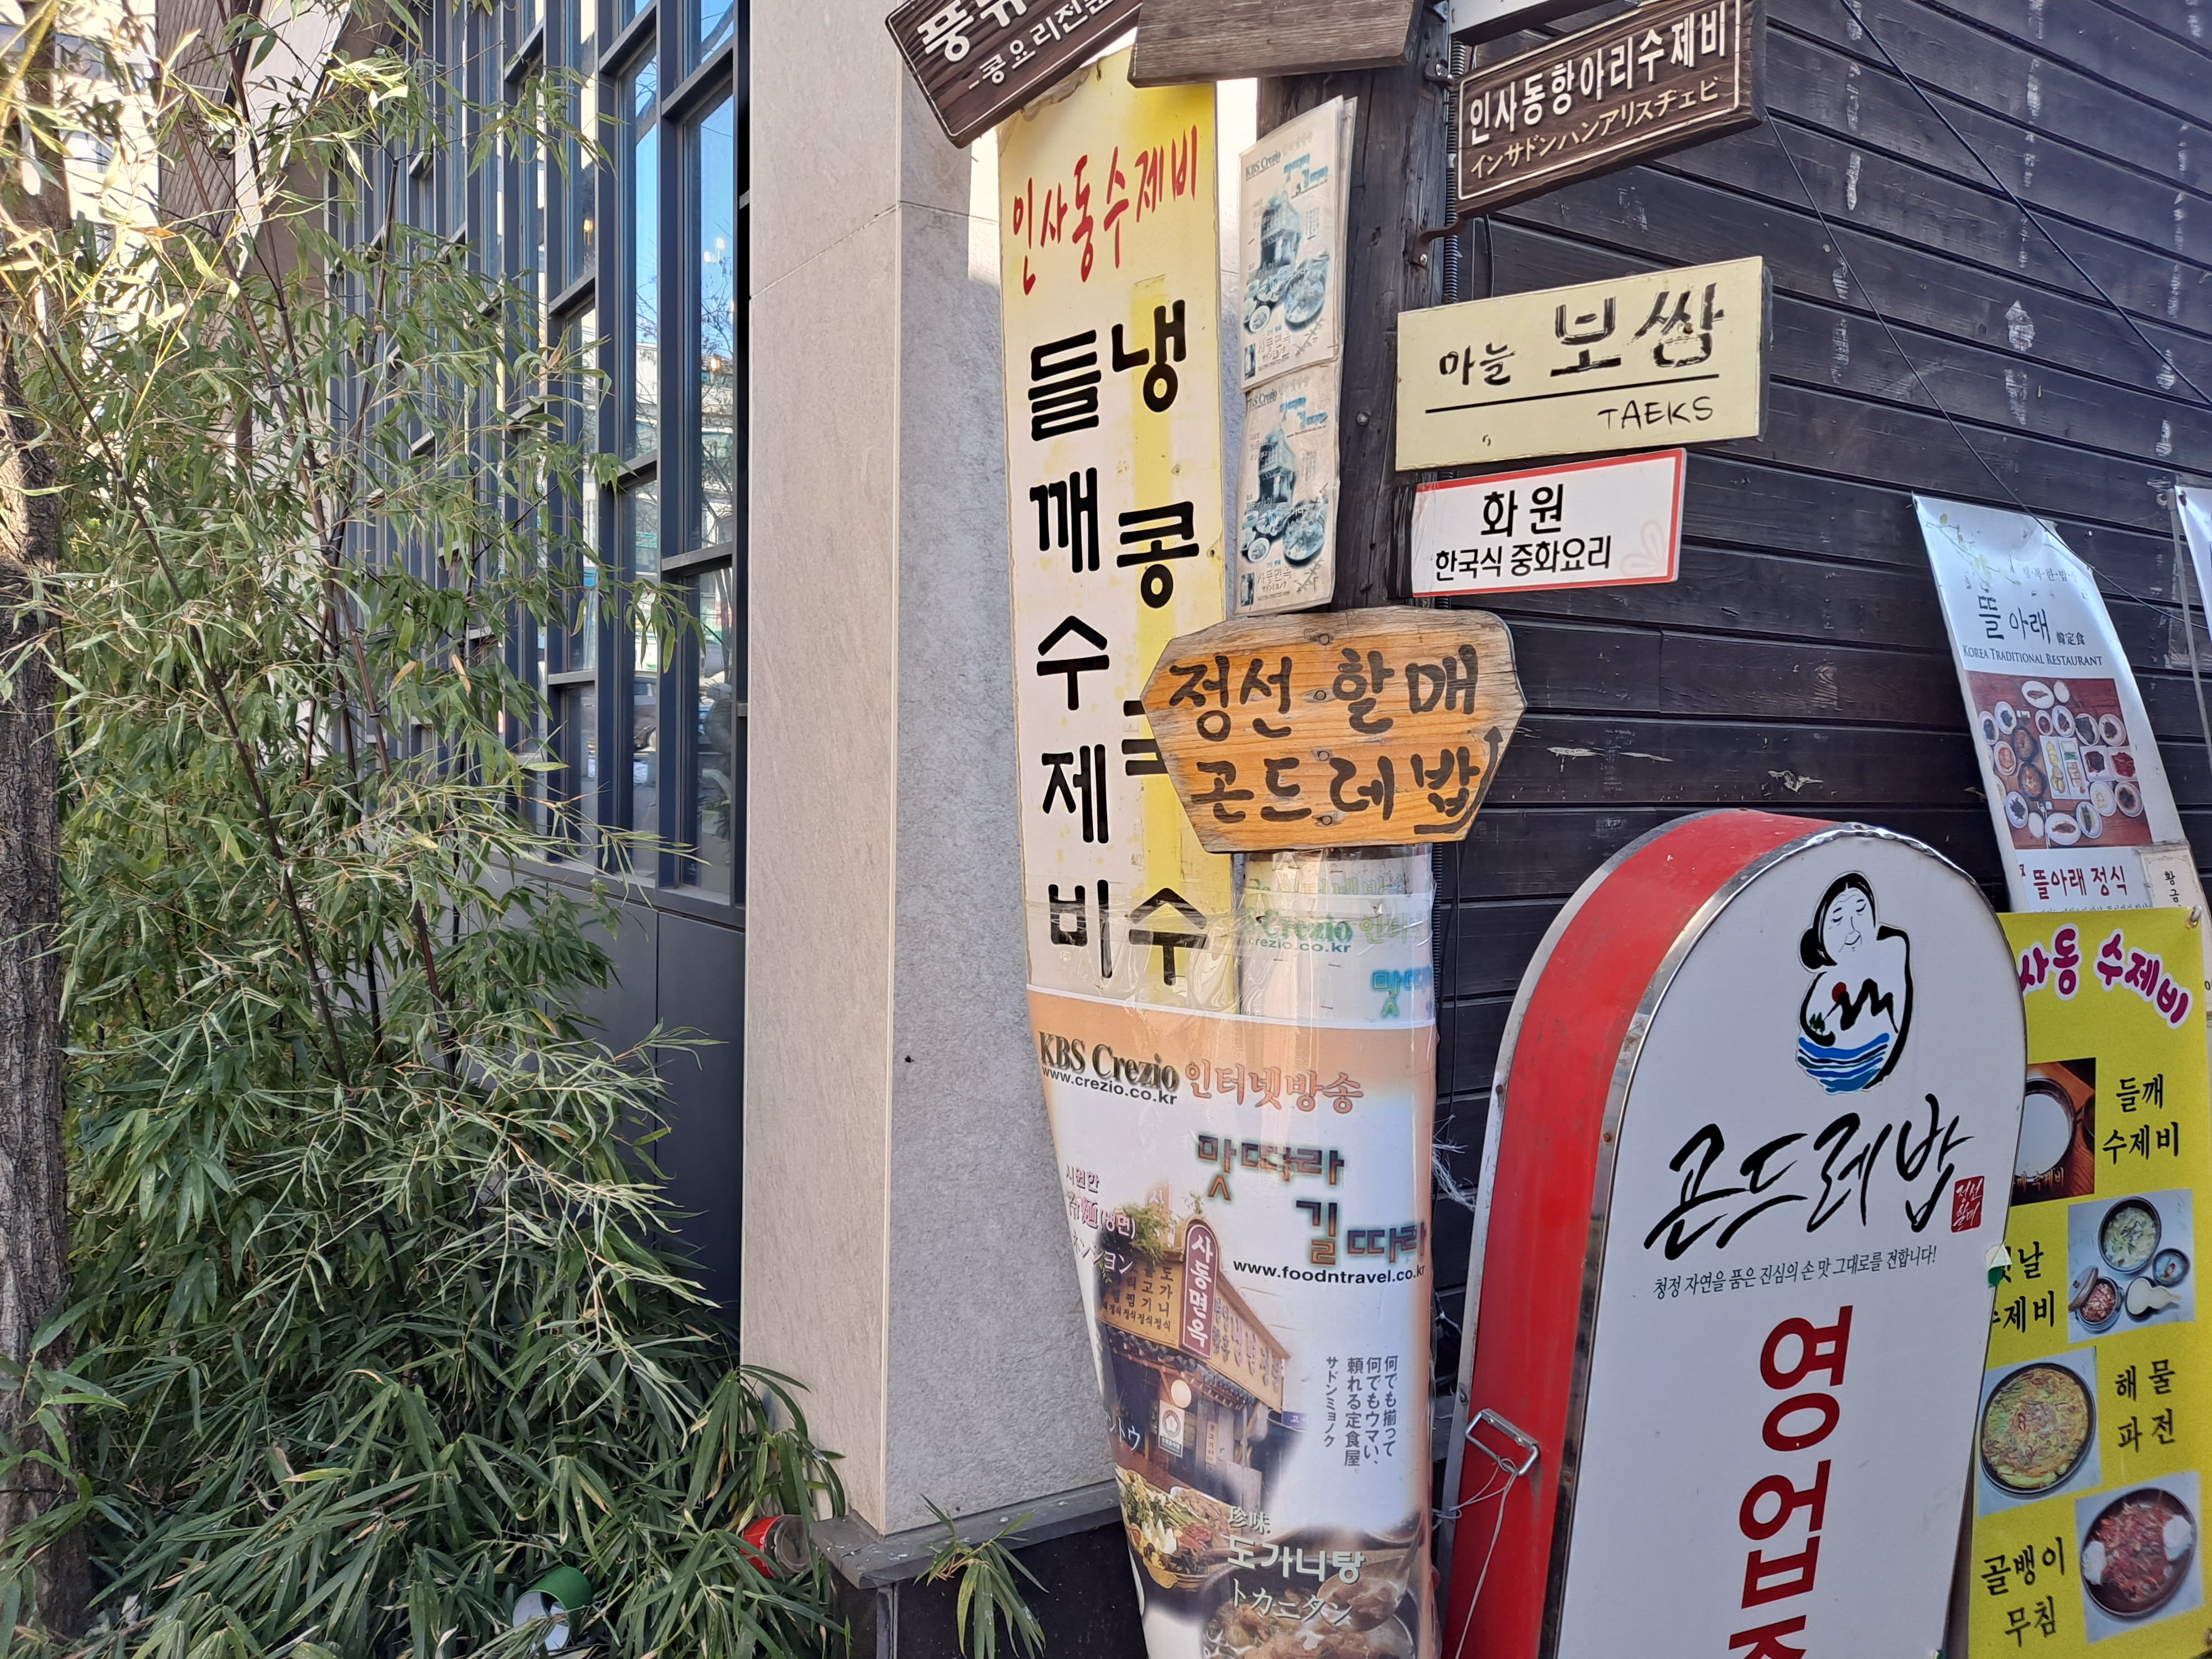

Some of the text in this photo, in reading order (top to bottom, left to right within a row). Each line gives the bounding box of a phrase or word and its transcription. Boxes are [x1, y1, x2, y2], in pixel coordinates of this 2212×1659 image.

[1470, 0, 1726, 145] 인사동항아리수제비
[1013, 124, 1198, 295] 인사동수제비
[1439, 282, 1724, 385] 마늘 보쌈
[1597, 396, 1713, 429] TAEKS
[1435, 535, 1611, 582] 한국식 중화요리
[1169, 644, 1479, 742] 정선 할매
[1191, 747, 1480, 823] 곤드레밥
[2090, 865, 2127, 896] 정식
[2098, 933, 2189, 1023] 수제비
[1039, 1031, 1364, 1114] KBS Crezio 인터넷방송
[1042, 1065, 1177, 1105] www.crezio.co.kr
[2116, 1074, 2164, 1113] 들깨
[2103, 1121, 2179, 1165] 수제비
[1066, 1164, 1099, 1193] 시원한
[1198, 1135, 1344, 1201] 맛따라
[1644, 1094, 1975, 1261] 곤드레밥
[1296, 1200, 1427, 1265] 길따라
[1233, 1260, 1426, 1284] www.foodntravel.co.kr
[1653, 1276, 1681, 1300] 청정
[1684, 1270, 1726, 1296] 자연을
[1729, 1268, 1756, 1290] 품은
[1760, 1262, 1799, 1285] 진심의
[1801, 1260, 1815, 1281] 손
[1818, 1258, 1832, 1279] 맛
[1832, 1251, 1883, 1276] 그대로를
[2001, 1240, 2044, 1283] 날
[1991, 1290, 2056, 1333] 제비
[2115, 1358, 2176, 1402] 해물
[1383, 1355, 1399, 1457] 何でも揃って
[2117, 1408, 2176, 1452] 파전
[1227, 1534, 1366, 1584] 도가니탕
[1981, 1537, 2065, 1597] 골뱅이
[1233, 1578, 1353, 1624] トカニタン
[2005, 1596, 2058, 1647] 무침
